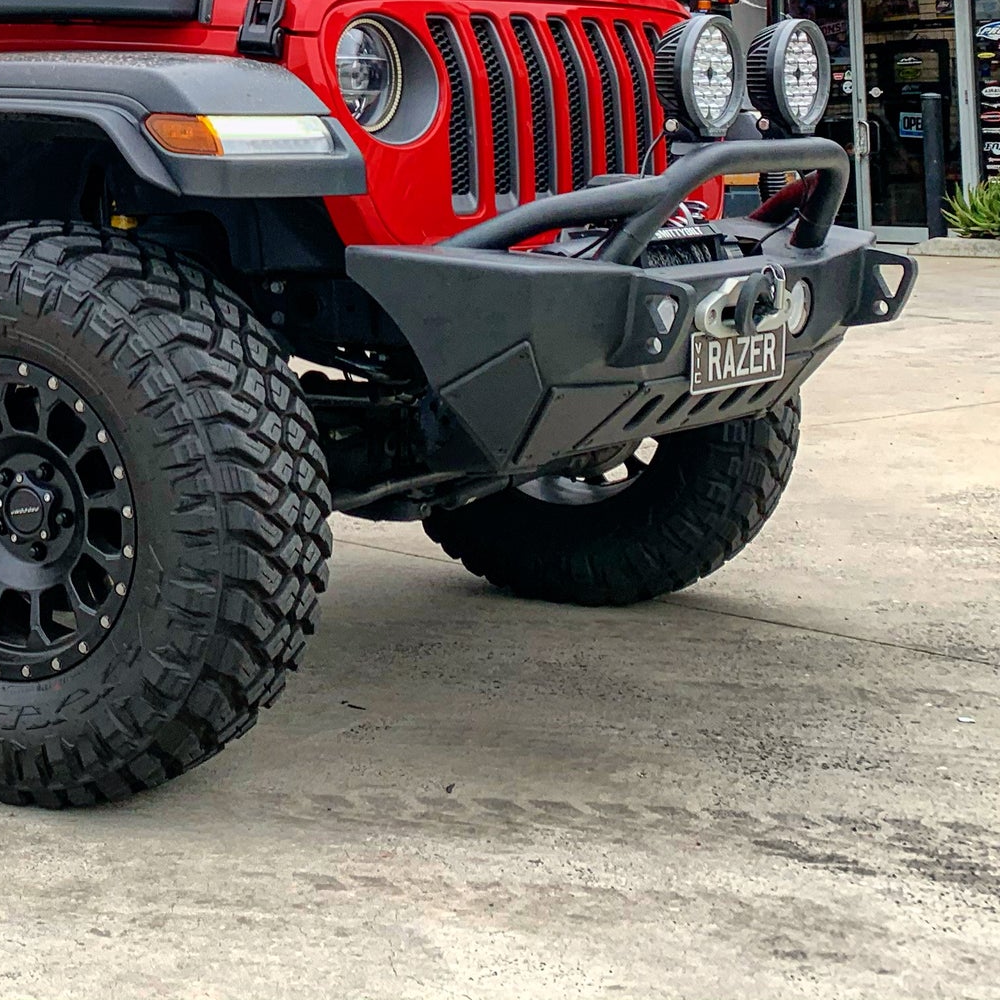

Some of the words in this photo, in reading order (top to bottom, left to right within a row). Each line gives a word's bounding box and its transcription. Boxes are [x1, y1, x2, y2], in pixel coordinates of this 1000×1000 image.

[903, 116, 923, 130] OPE
[694, 342, 702, 384] VIC
[708, 332, 776, 382] RAZER
